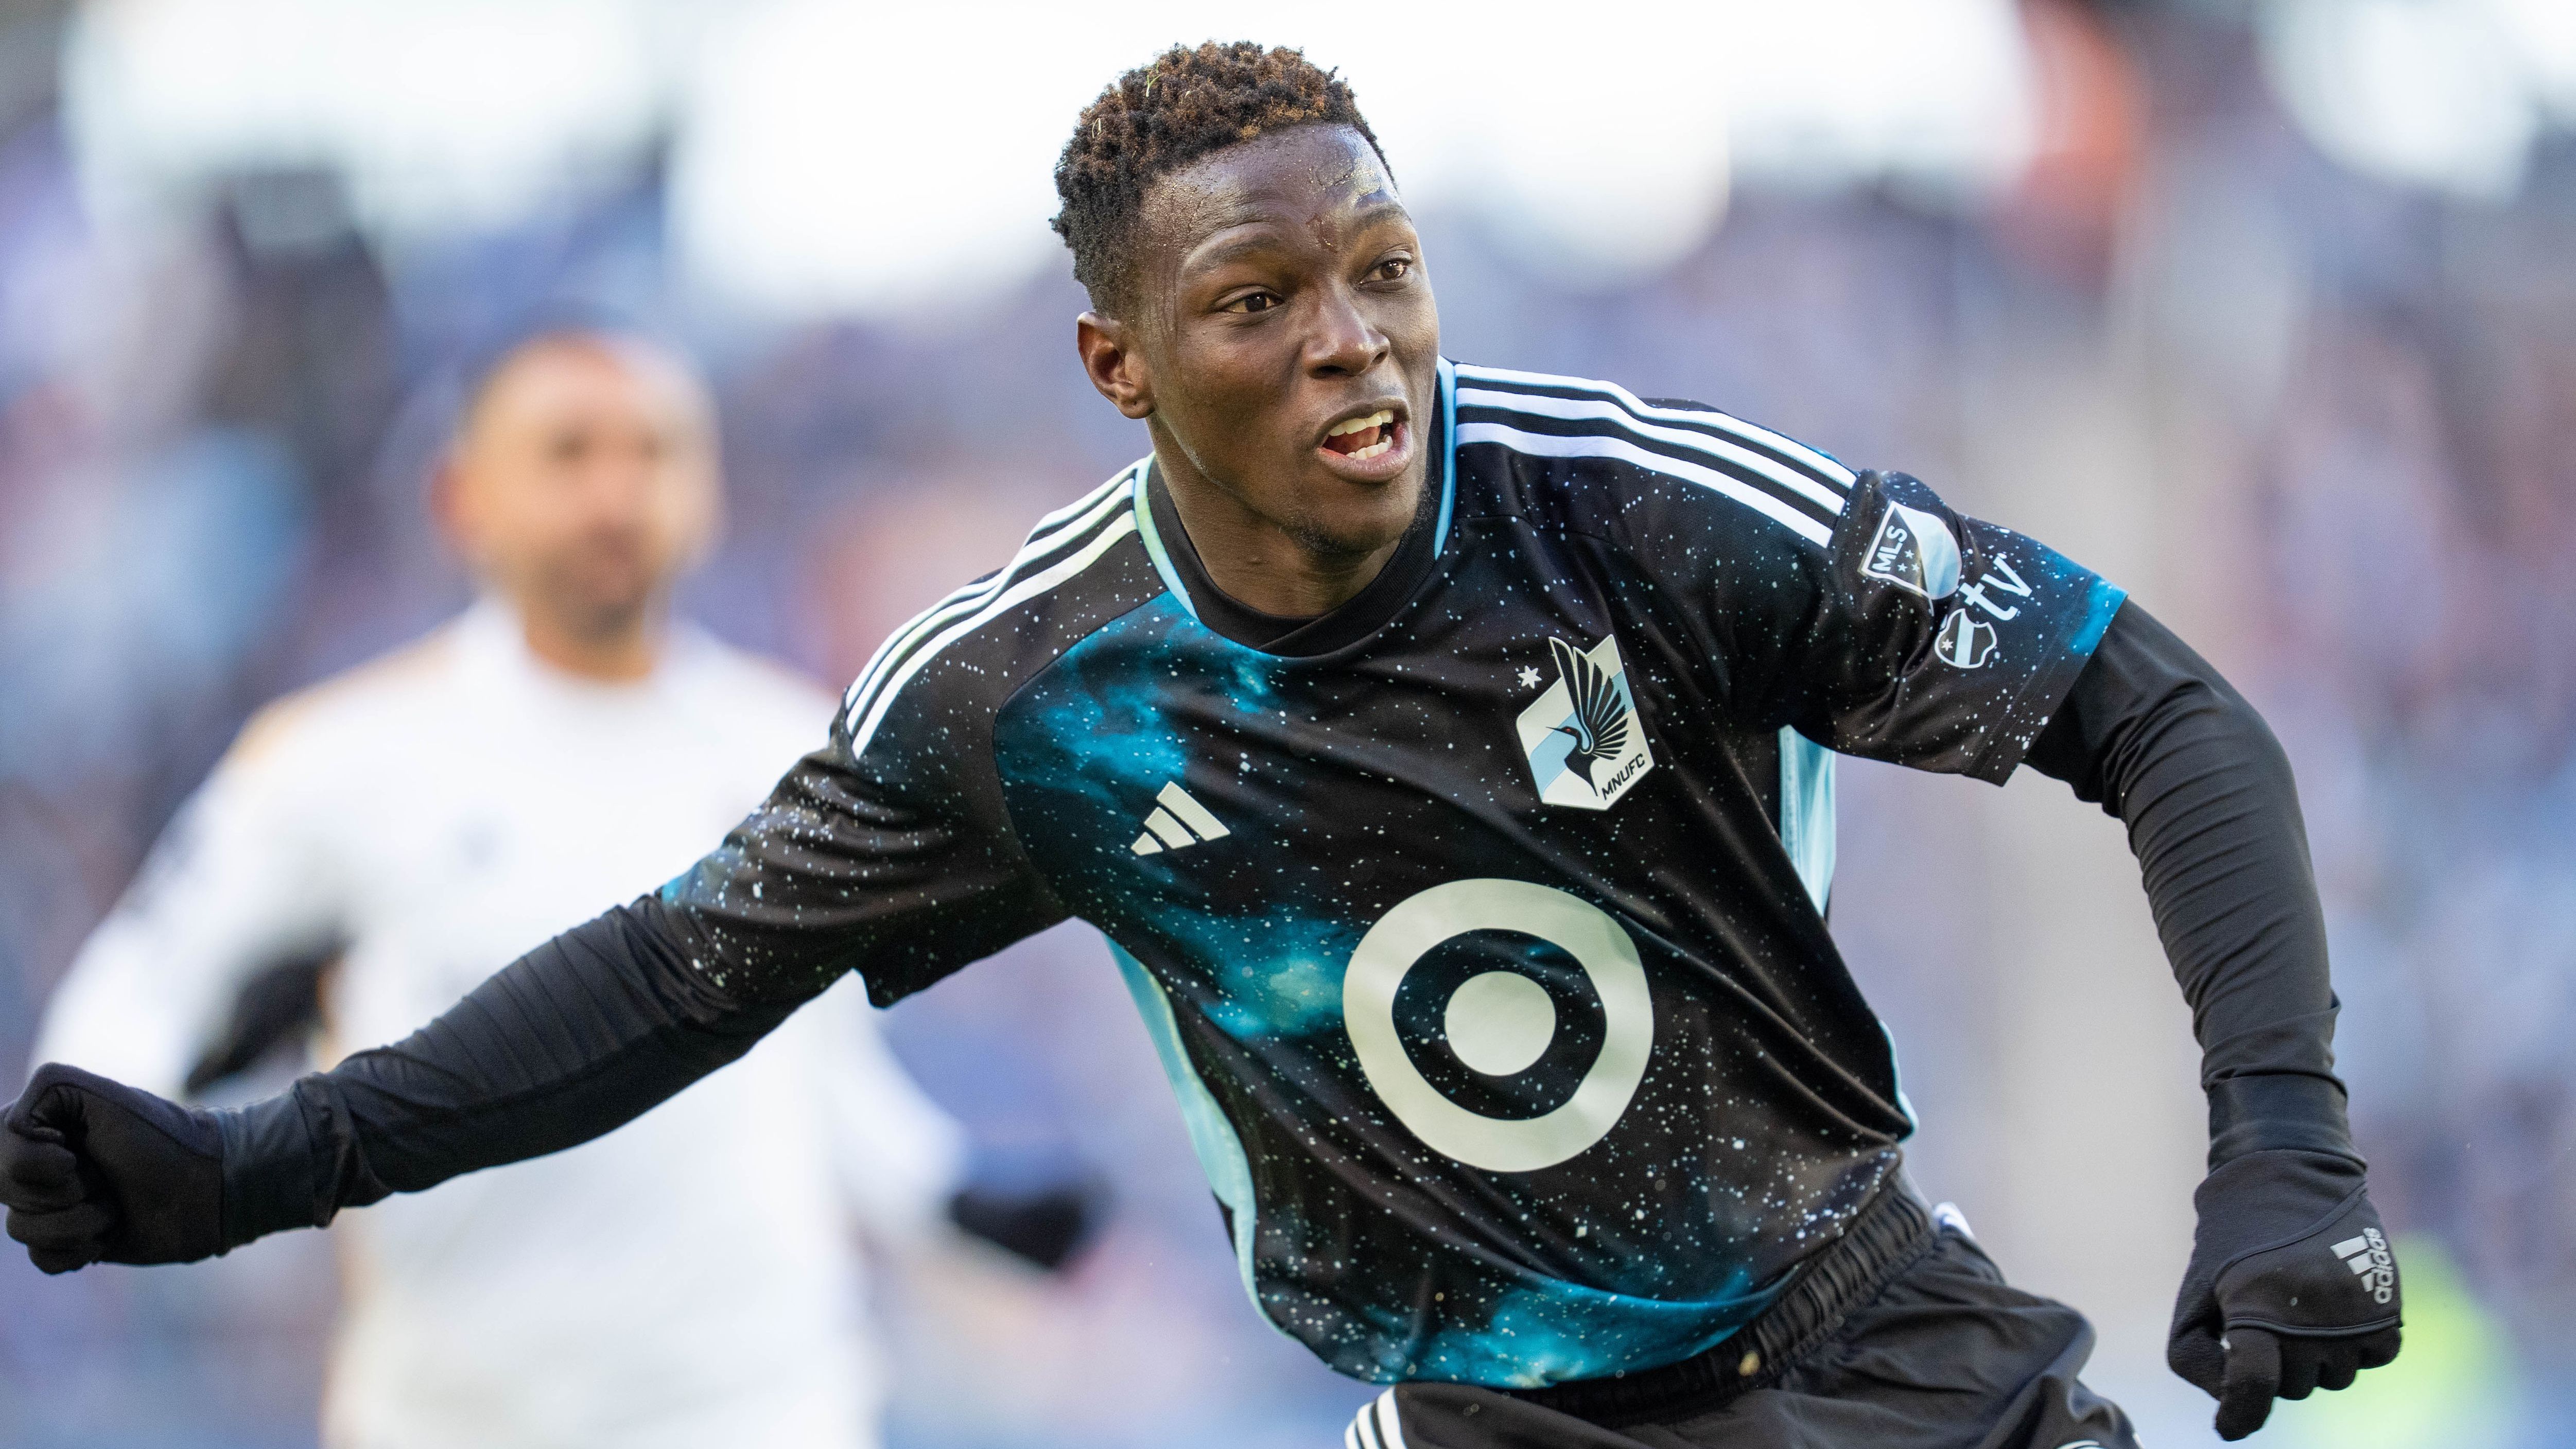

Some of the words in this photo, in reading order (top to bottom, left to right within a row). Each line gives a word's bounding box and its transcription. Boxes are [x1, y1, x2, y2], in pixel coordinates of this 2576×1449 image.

[1872, 525, 1908, 572] MLS
[1959, 555, 2033, 621] tv
[1602, 753, 1646, 800] MNUFC
[2363, 1227, 2394, 1304] adidas
